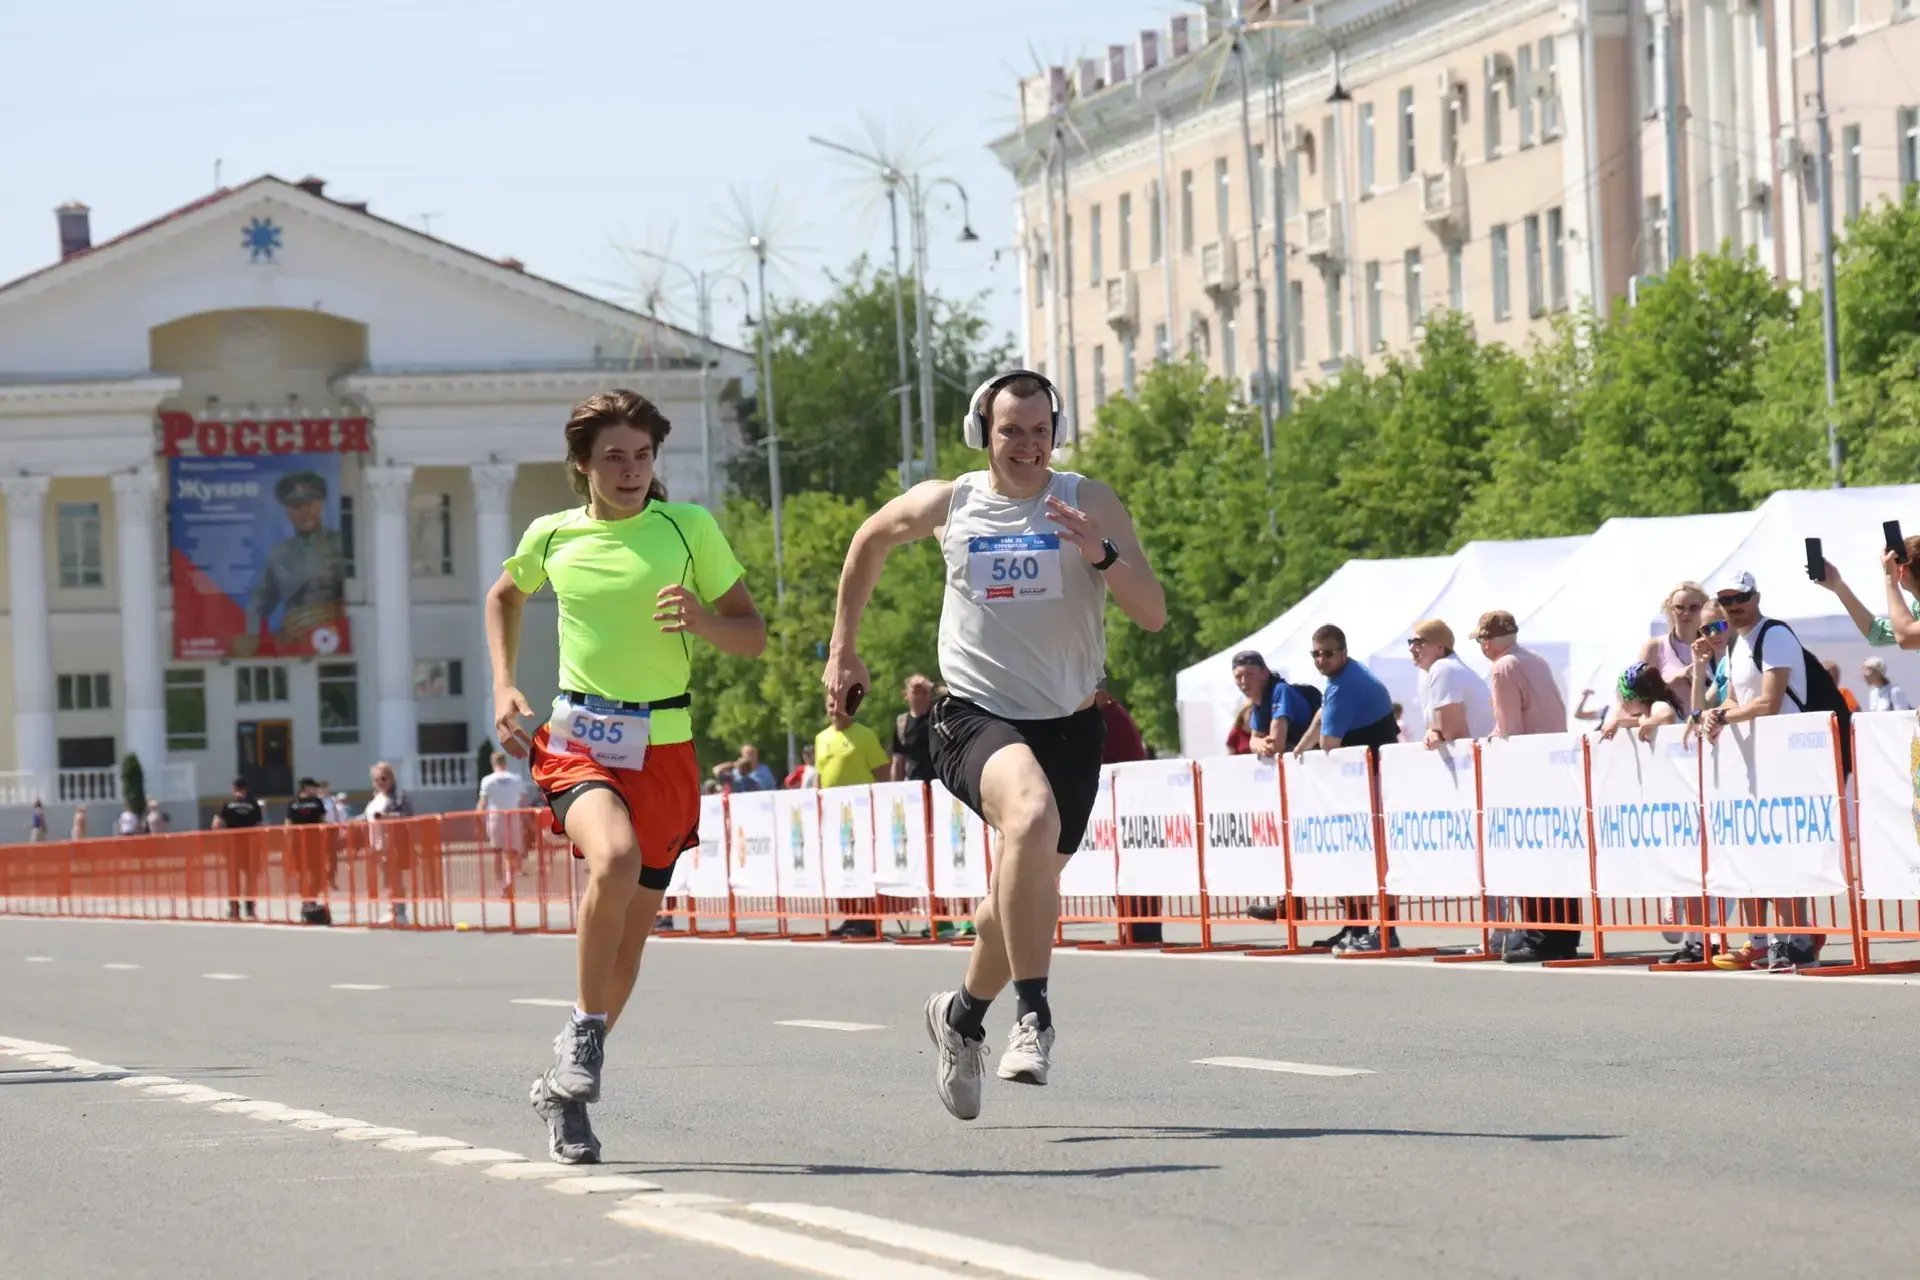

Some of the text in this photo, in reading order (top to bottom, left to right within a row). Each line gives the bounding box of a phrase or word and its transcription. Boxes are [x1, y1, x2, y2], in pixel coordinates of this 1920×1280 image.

[991, 556, 1039, 581] 560
[571, 714, 625, 745] 585
[1120, 815, 1193, 849] ZAURALMAN
[1209, 812, 1280, 848] ZAURALMAN
[1292, 812, 1373, 854] ИНГОССТРАХ
[1387, 808, 1476, 852] ИНГОССТРАХ
[1486, 806, 1585, 849] ИНГОССТРАХ
[1598, 801, 1701, 849] ИНГОССТРАХ
[1709, 795, 1836, 846] ИНГОССТРАХ
